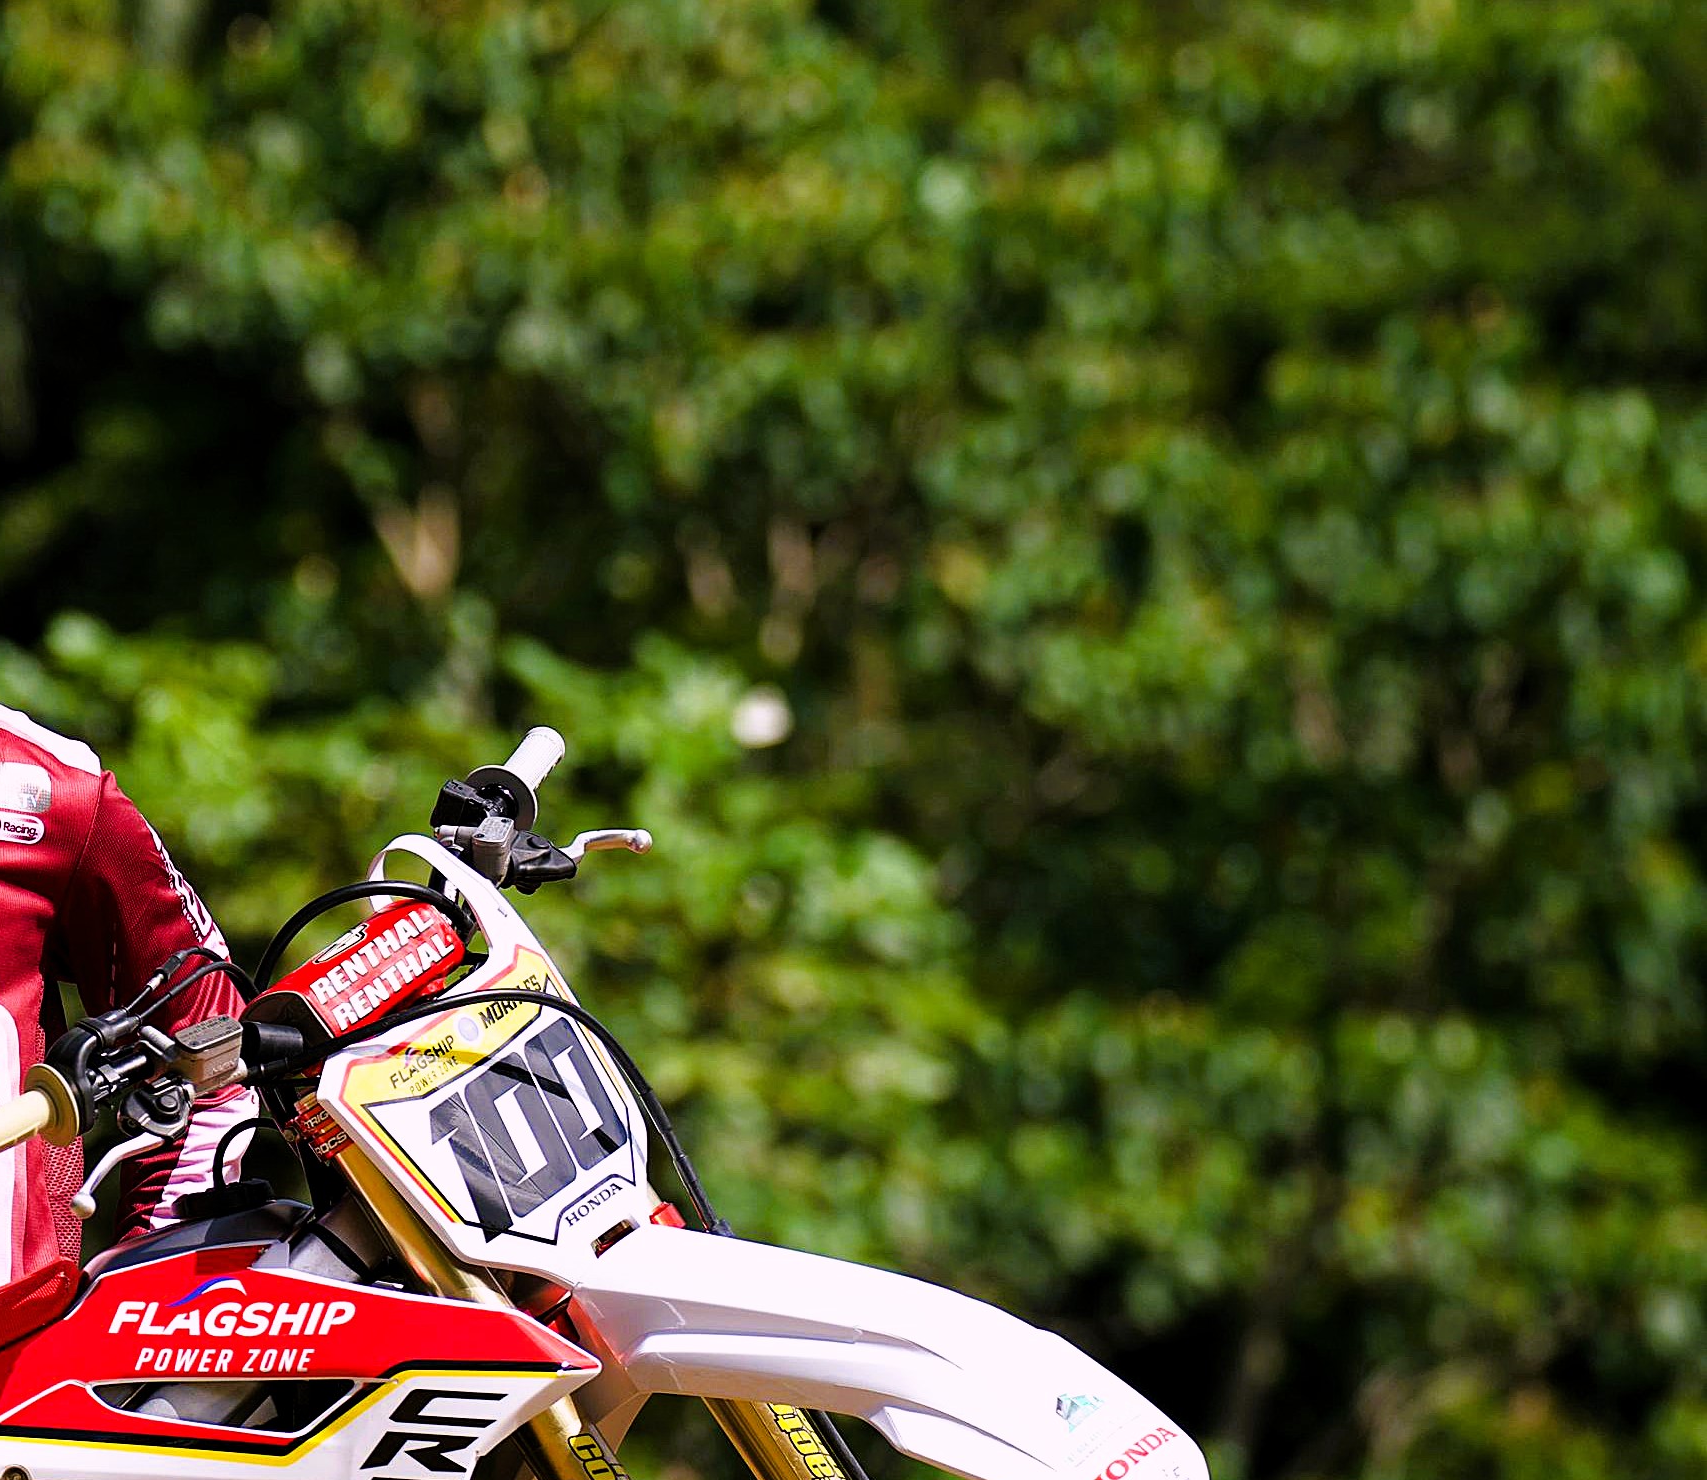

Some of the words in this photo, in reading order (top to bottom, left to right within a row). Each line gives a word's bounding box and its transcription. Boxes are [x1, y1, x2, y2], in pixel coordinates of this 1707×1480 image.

[309, 910, 435, 1005] RENTHAL
[332, 932, 455, 1031] RENTHAL
[390, 1035, 454, 1089] FLAGSHIP
[429, 1016, 627, 1243] 100
[564, 1181, 625, 1228] HONDA
[108, 1301, 356, 1336] FLAGSHIP
[135, 1347, 231, 1373] POWER
[243, 1347, 315, 1372] ZONE
